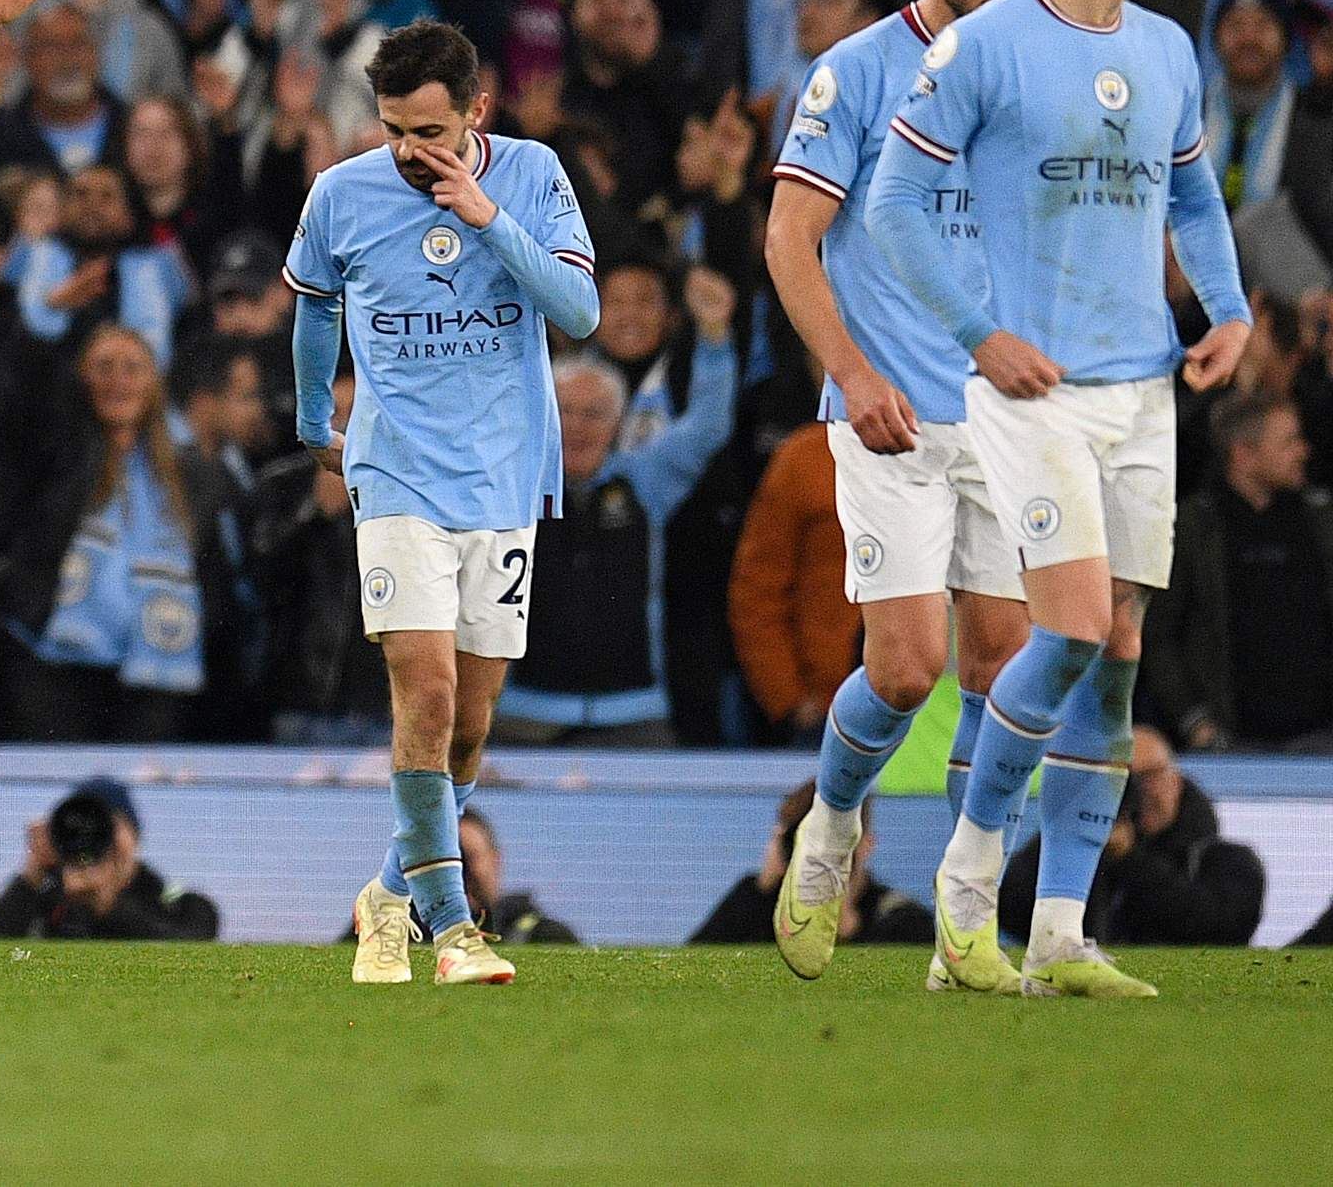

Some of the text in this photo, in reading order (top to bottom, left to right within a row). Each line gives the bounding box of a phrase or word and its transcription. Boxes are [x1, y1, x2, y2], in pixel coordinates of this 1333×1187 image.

[1069, 191, 1149, 209] AIRWAY
[371, 302, 523, 335] ETIHAD
[397, 337, 501, 358] AIRWAYS
